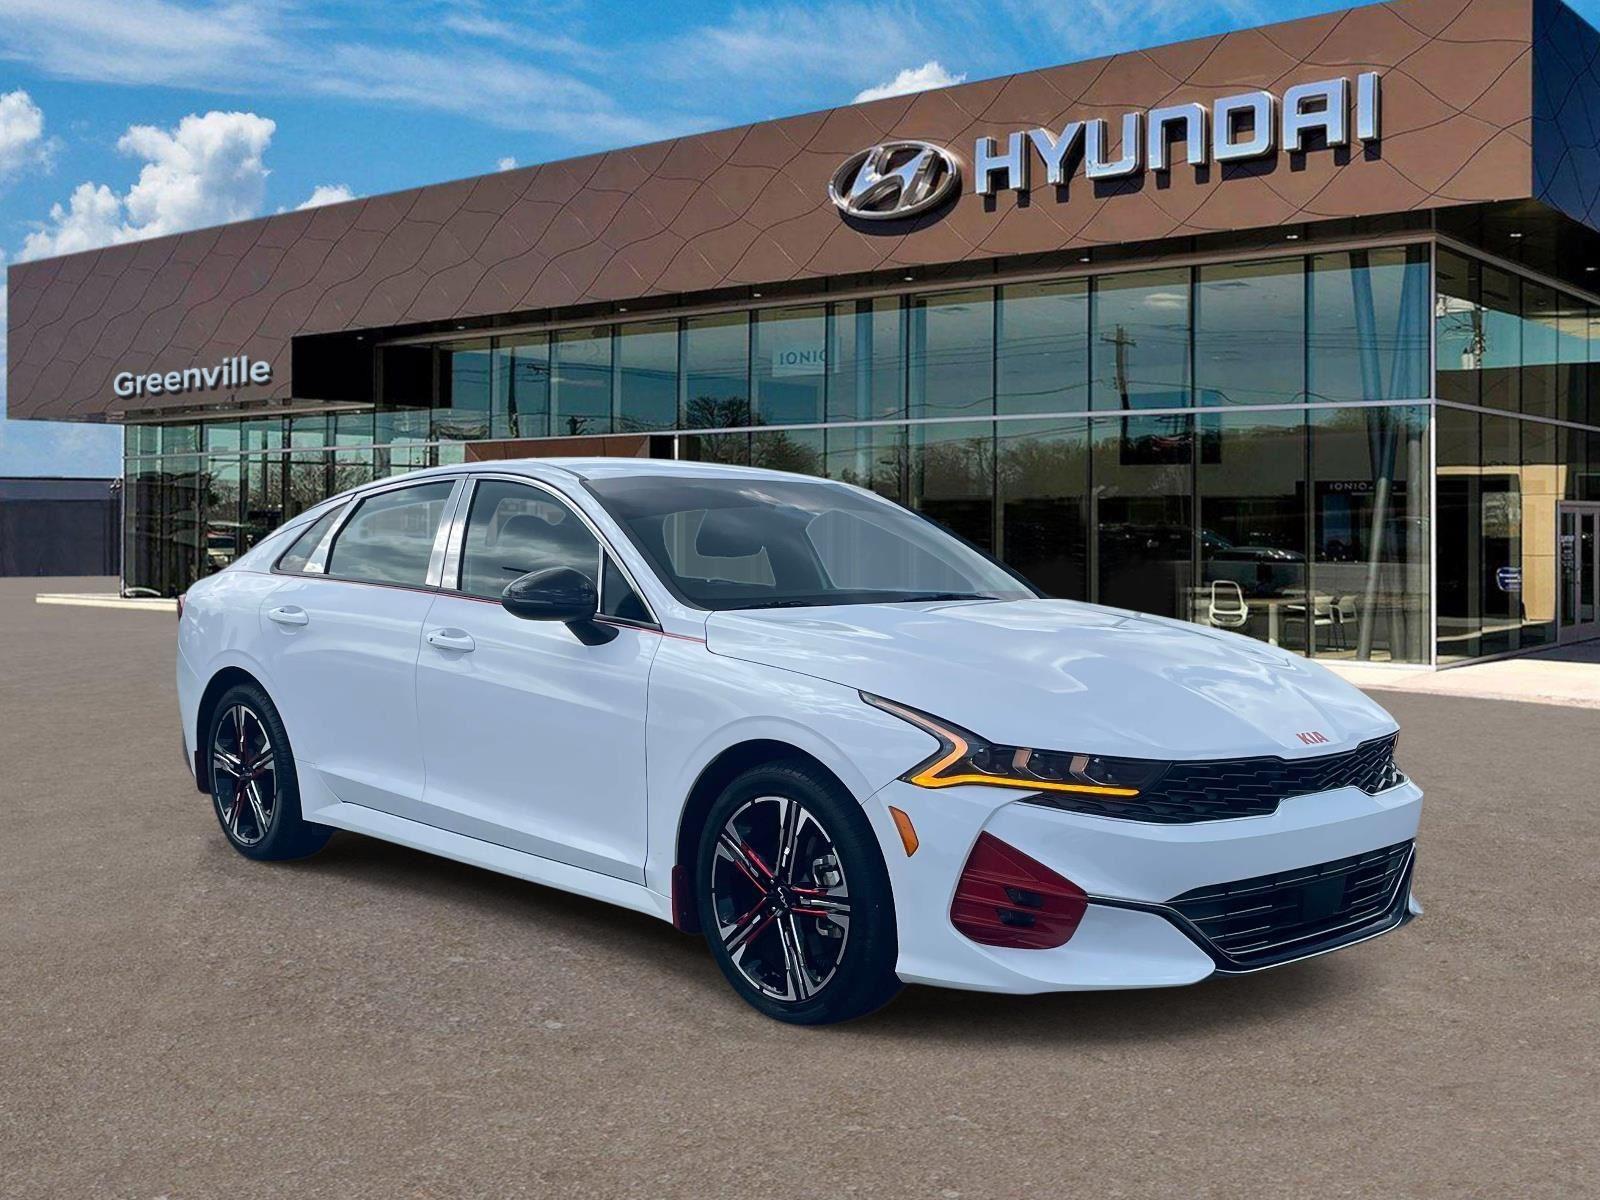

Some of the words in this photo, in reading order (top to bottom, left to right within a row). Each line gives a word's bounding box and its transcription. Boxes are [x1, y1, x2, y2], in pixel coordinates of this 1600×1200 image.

[974, 71, 1381, 196] HYUNDAI
[114, 355, 271, 398] Greenville
[1296, 731, 1330, 745] KIA
